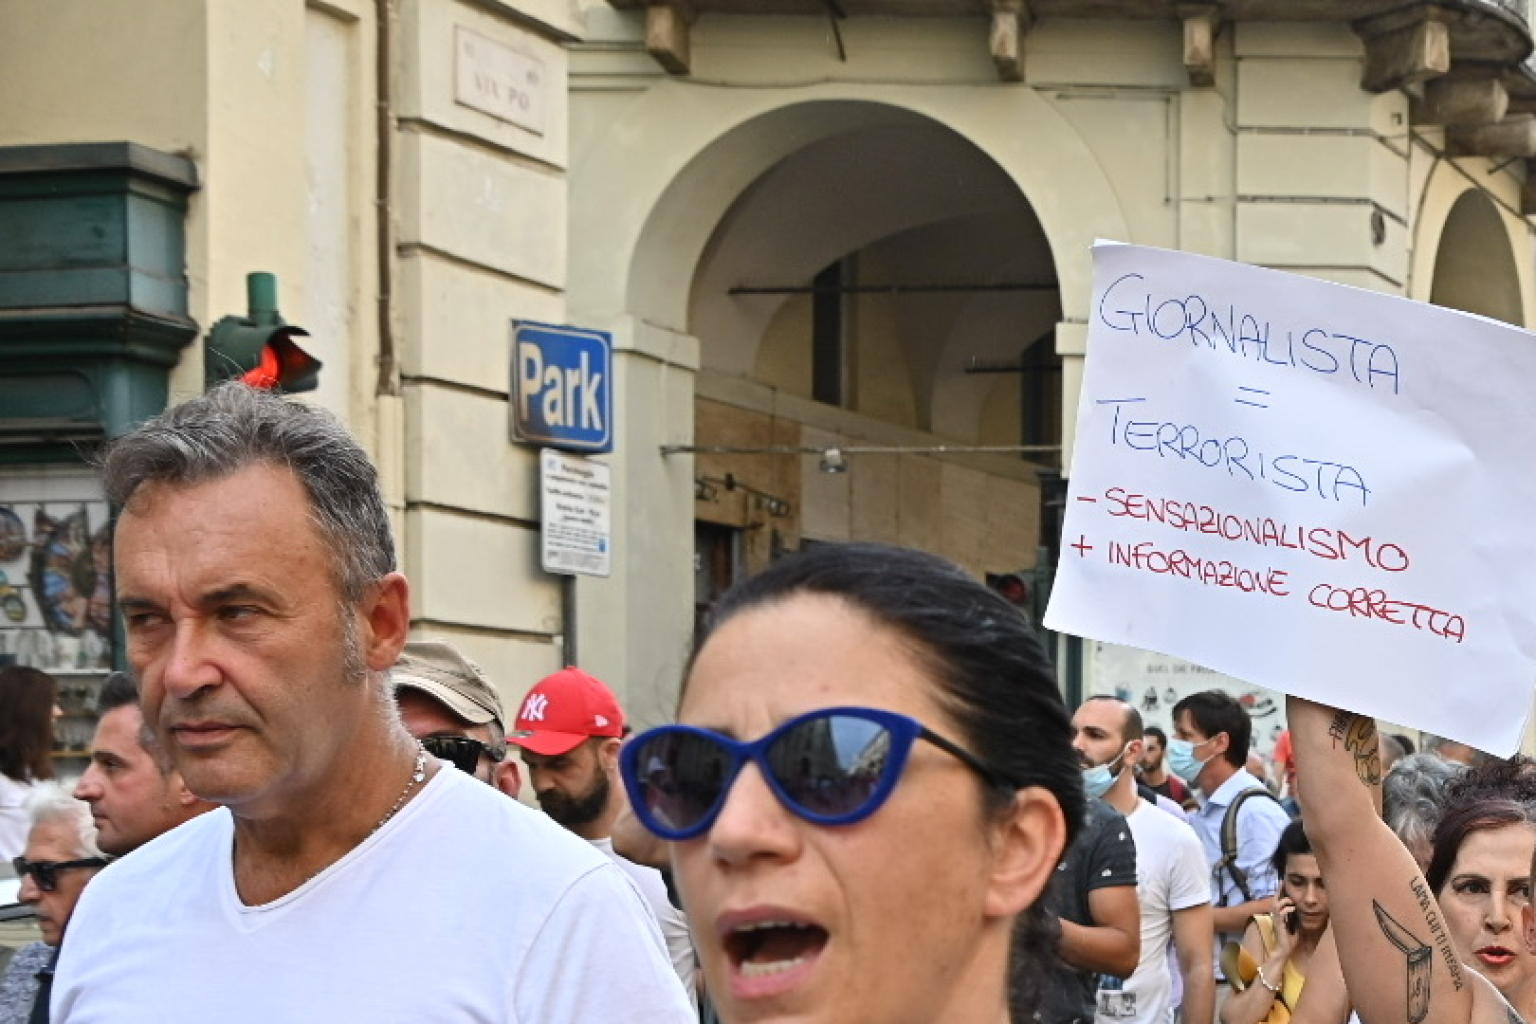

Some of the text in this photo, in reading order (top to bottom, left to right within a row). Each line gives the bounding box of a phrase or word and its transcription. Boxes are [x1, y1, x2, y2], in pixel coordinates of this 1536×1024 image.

[1100, 273, 1400, 394] GIORNALISTA
[519, 341, 603, 430] Park
[1096, 397, 1371, 507] TERRORISTA
[1104, 487, 1410, 572] SENSAZIONALISMO
[1109, 541, 1290, 597] INFORMAZIONE
[1308, 583, 1466, 644] CORRETTA
